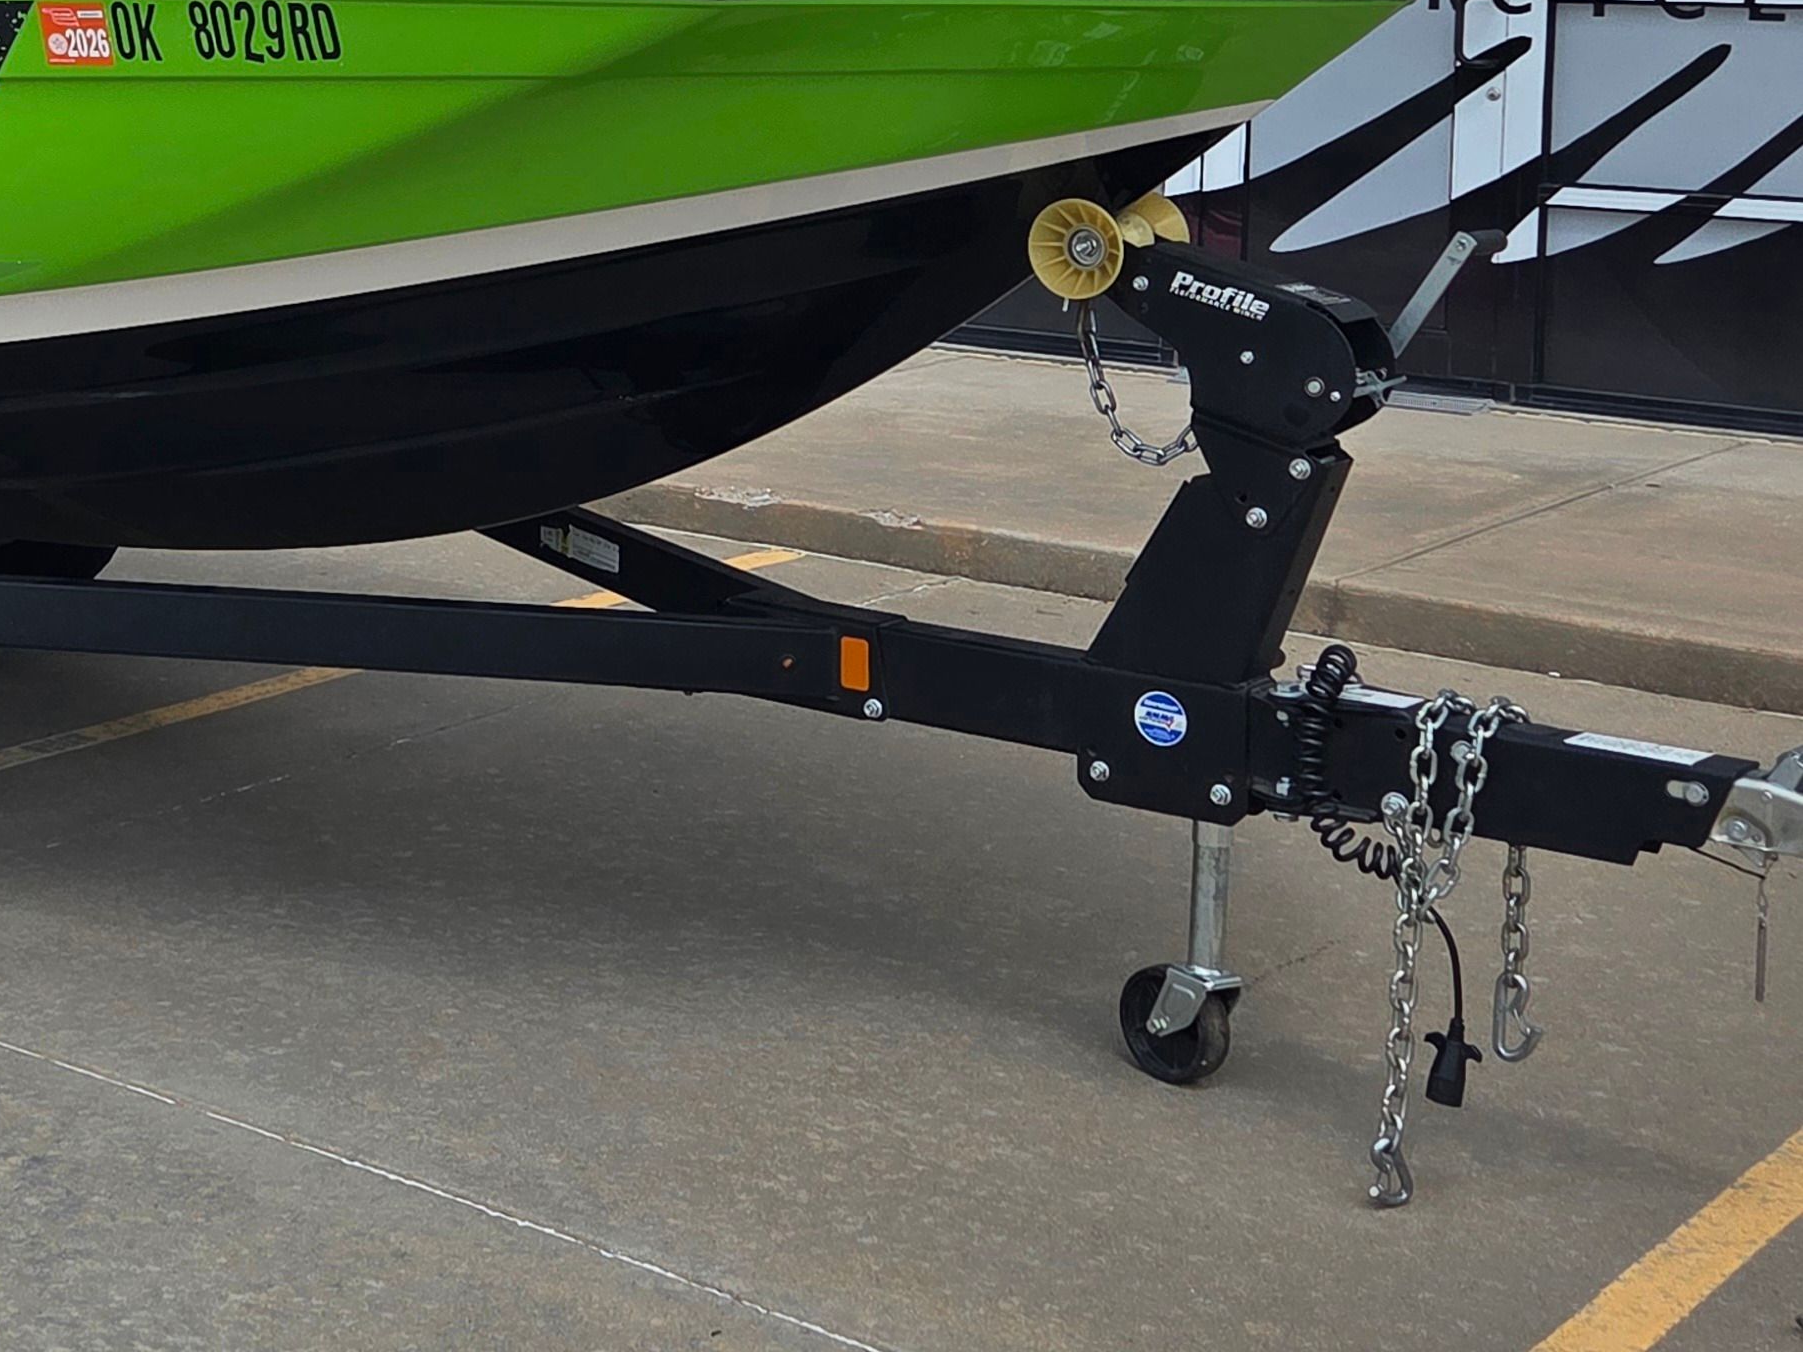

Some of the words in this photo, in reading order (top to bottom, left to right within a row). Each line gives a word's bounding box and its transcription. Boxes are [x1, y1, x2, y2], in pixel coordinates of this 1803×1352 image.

[64, 27, 111, 58] 2026
[110, 0, 164, 61] OK
[188, 0, 342, 63] 8029RD
[1172, 271, 1271, 317] Profile
